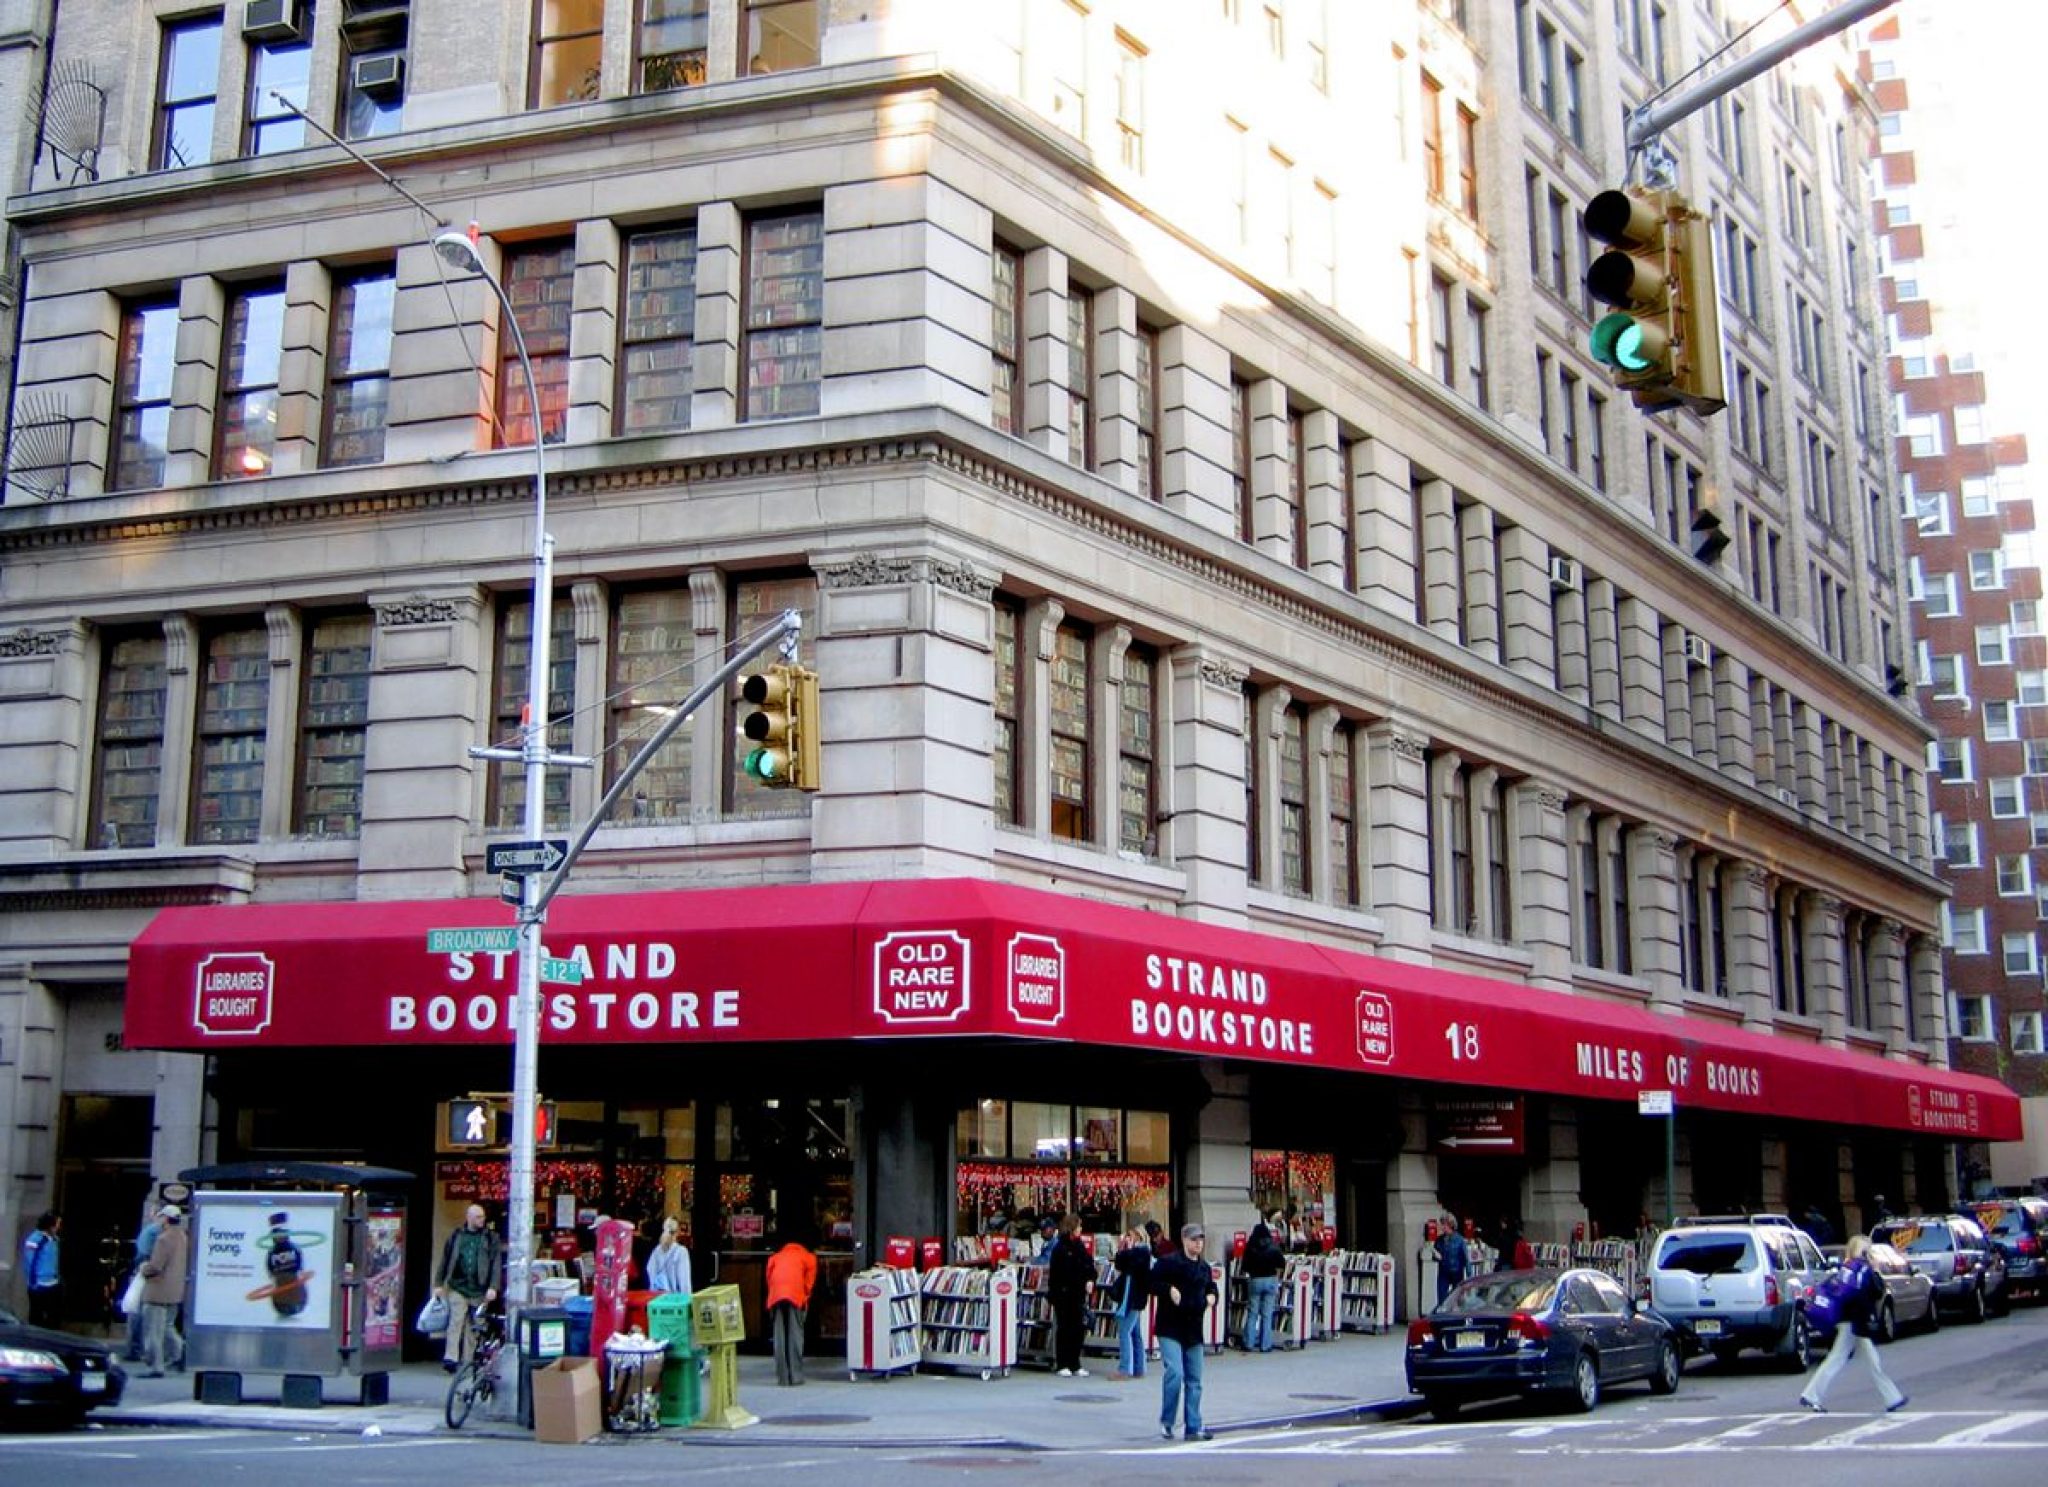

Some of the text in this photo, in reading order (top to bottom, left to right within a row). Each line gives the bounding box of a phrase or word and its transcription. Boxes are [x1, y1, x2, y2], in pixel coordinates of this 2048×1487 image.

[495, 848, 556, 865] ONE WAY
[434, 931, 512, 950] BROADWAY
[449, 943, 676, 979] STAND
[898, 943, 947, 962] OLD
[551, 962, 568, 980] 12
[1015, 953, 1058, 978] LIBRARIES
[206, 972, 265, 991] LIBRARIES
[889, 967, 954, 986] RARE
[1146, 954, 1267, 1004] STRAND
[894, 990, 949, 1009] NEW
[1018, 982, 1054, 1006] BOUGHT
[209, 997, 257, 1016] BOUGHT
[1365, 1001, 1384, 1018] OLD
[1131, 999, 1314, 1054] BOOKSTORE
[1361, 1019, 1388, 1037] RARE
[1364, 1038, 1386, 1054] NEW
[1445, 1022, 1760, 1096] 18 MILES OF BOOKS
[208, 1227, 246, 1241] Forever
